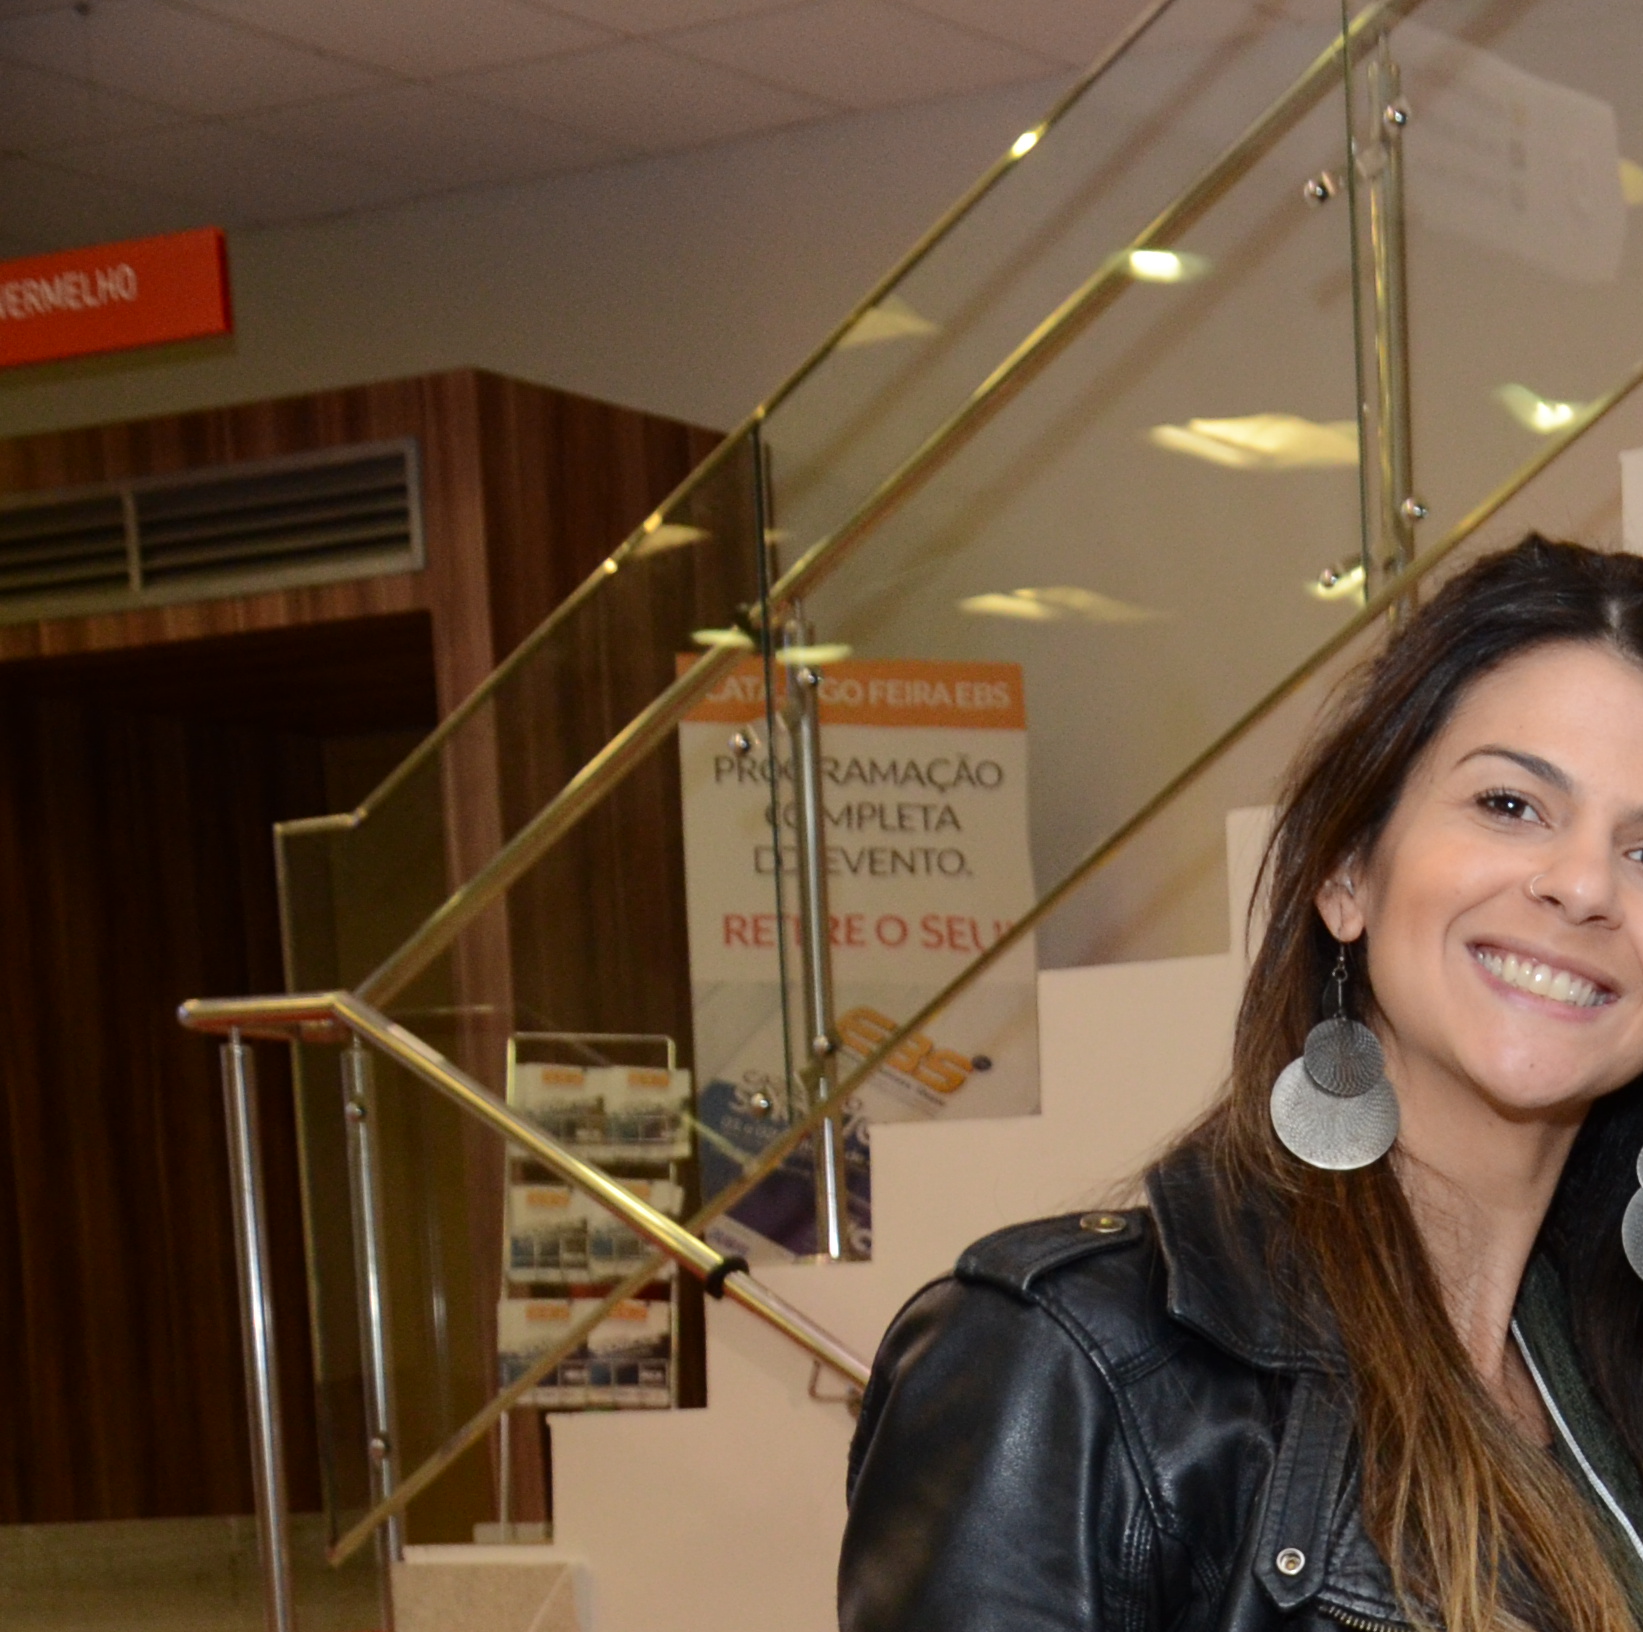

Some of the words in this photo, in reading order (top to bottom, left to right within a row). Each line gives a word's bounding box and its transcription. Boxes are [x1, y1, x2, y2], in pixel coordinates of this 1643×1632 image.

[868, 680, 950, 708] FEIRA
[955, 681, 1011, 709] EBS
[724, 914, 866, 947] RETRE
[875, 915, 909, 947] O
